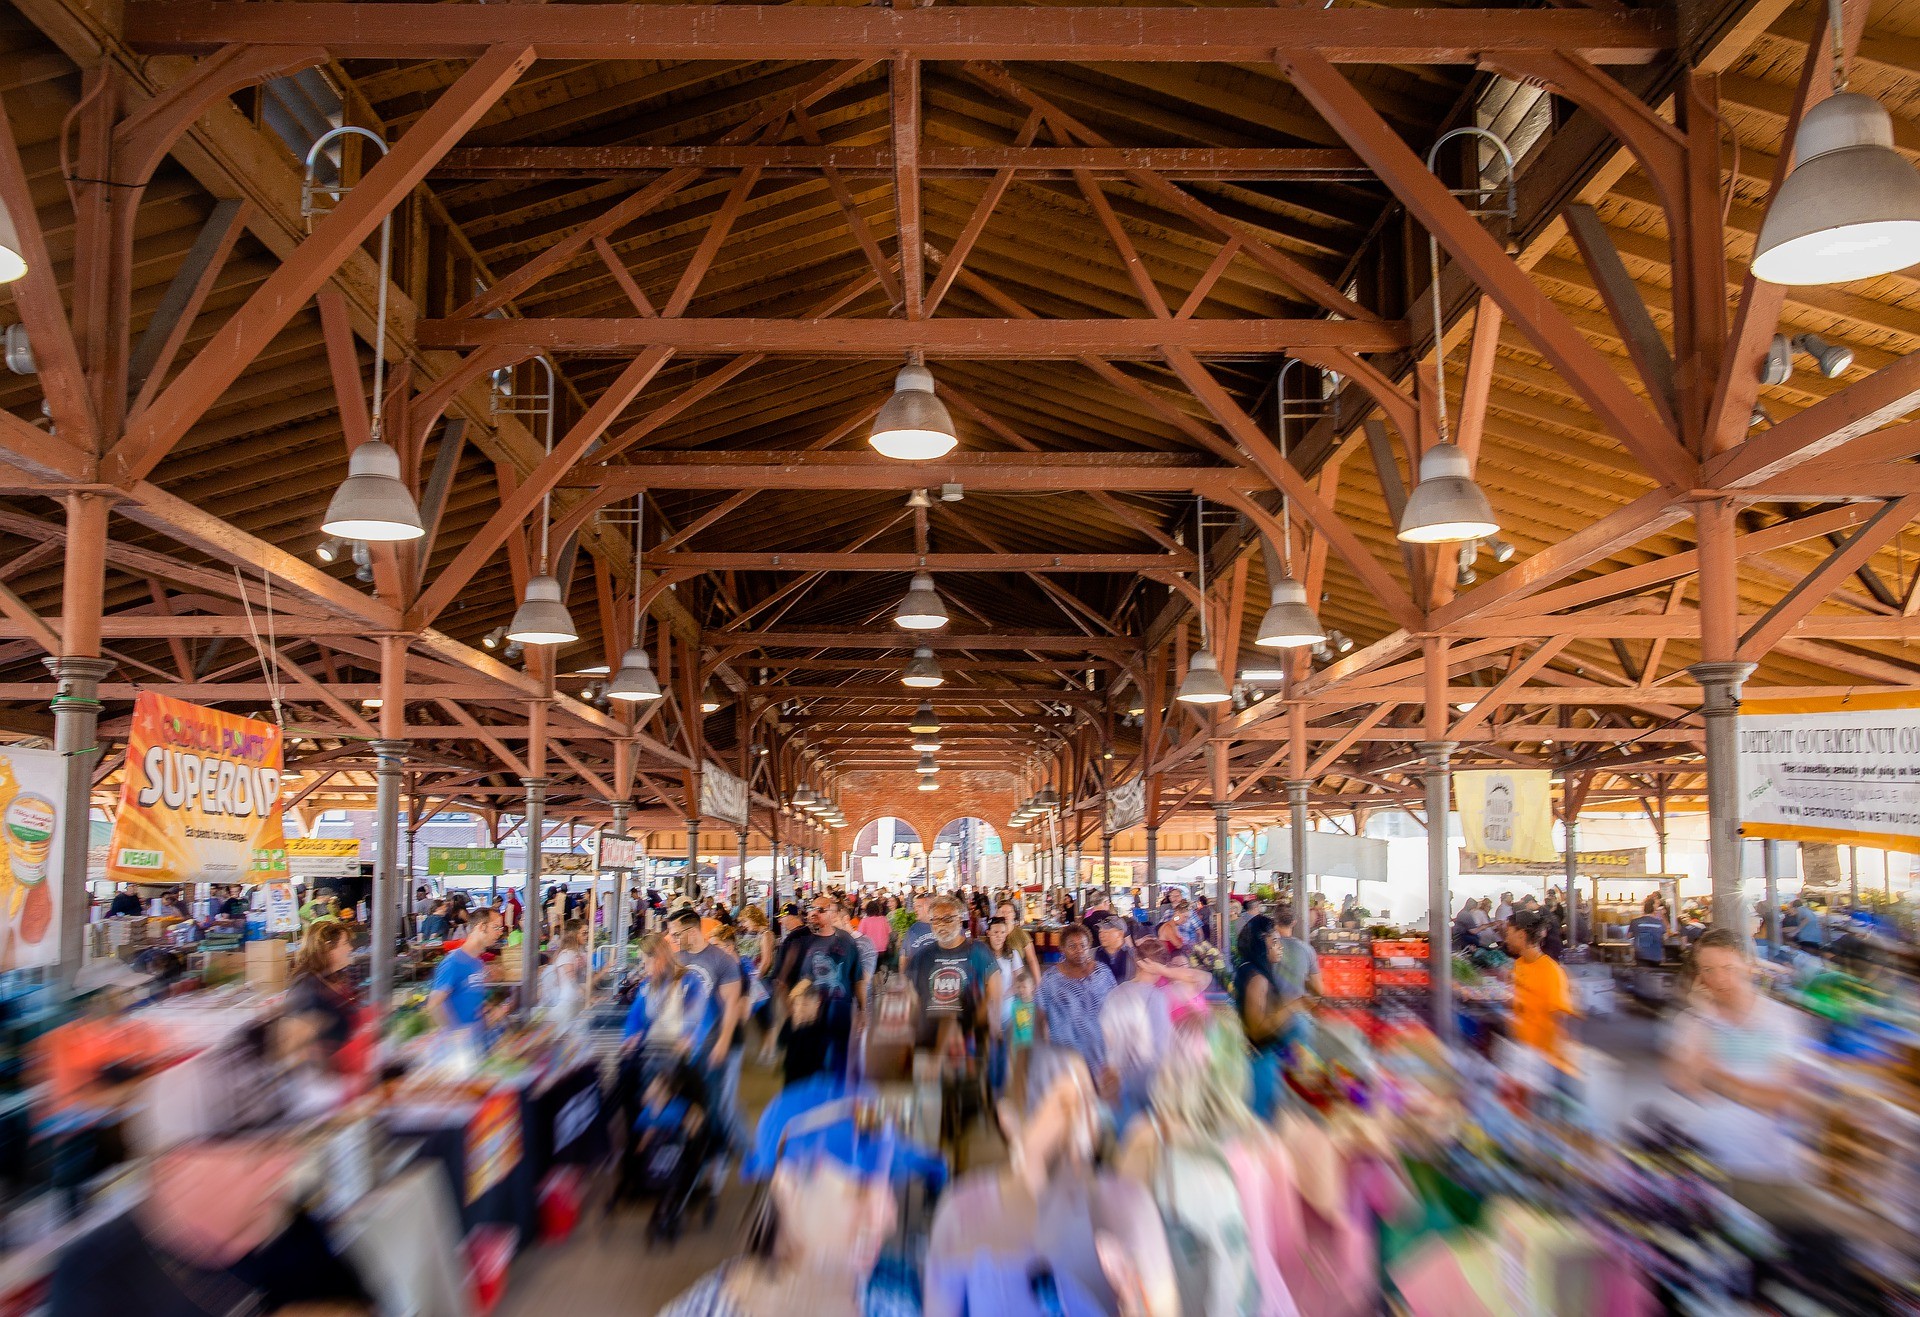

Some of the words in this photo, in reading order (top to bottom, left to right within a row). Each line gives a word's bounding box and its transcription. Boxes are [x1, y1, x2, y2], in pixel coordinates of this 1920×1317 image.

[1740, 729, 1794, 754] DETROIT
[1795, 728, 1862, 754] GOURMET
[1866, 727, 1897, 754] NUT
[138, 745, 281, 819] SUPERDIP
[122, 851, 159, 866] VEGAN
